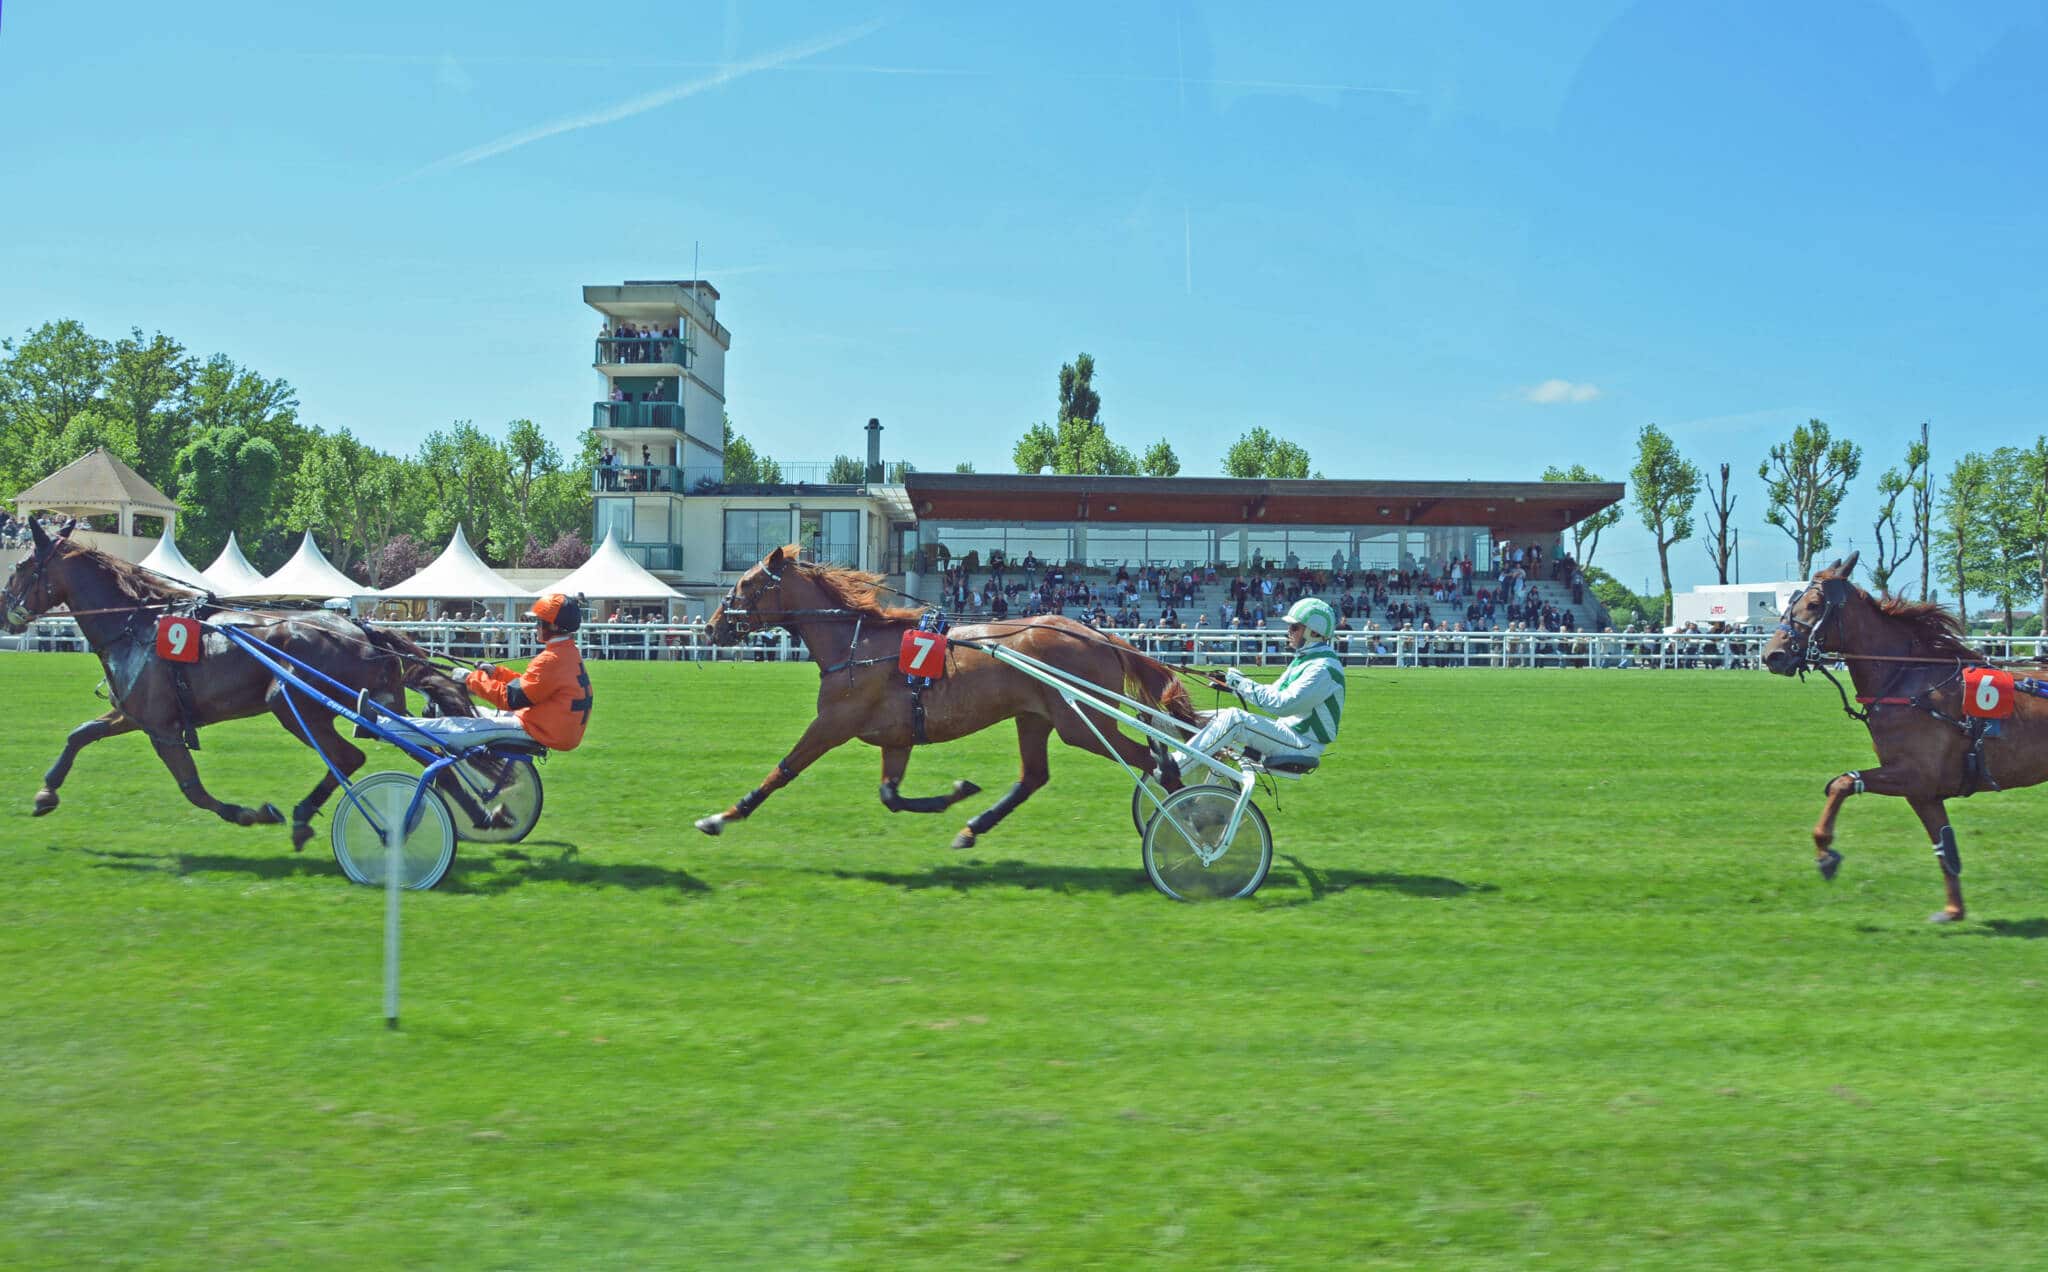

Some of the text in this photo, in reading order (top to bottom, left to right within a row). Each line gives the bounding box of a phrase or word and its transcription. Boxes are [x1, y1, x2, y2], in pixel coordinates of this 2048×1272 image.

[168, 623, 188, 655] 9
[910, 636, 936, 669] 7
[1976, 675, 2000, 711] 6
